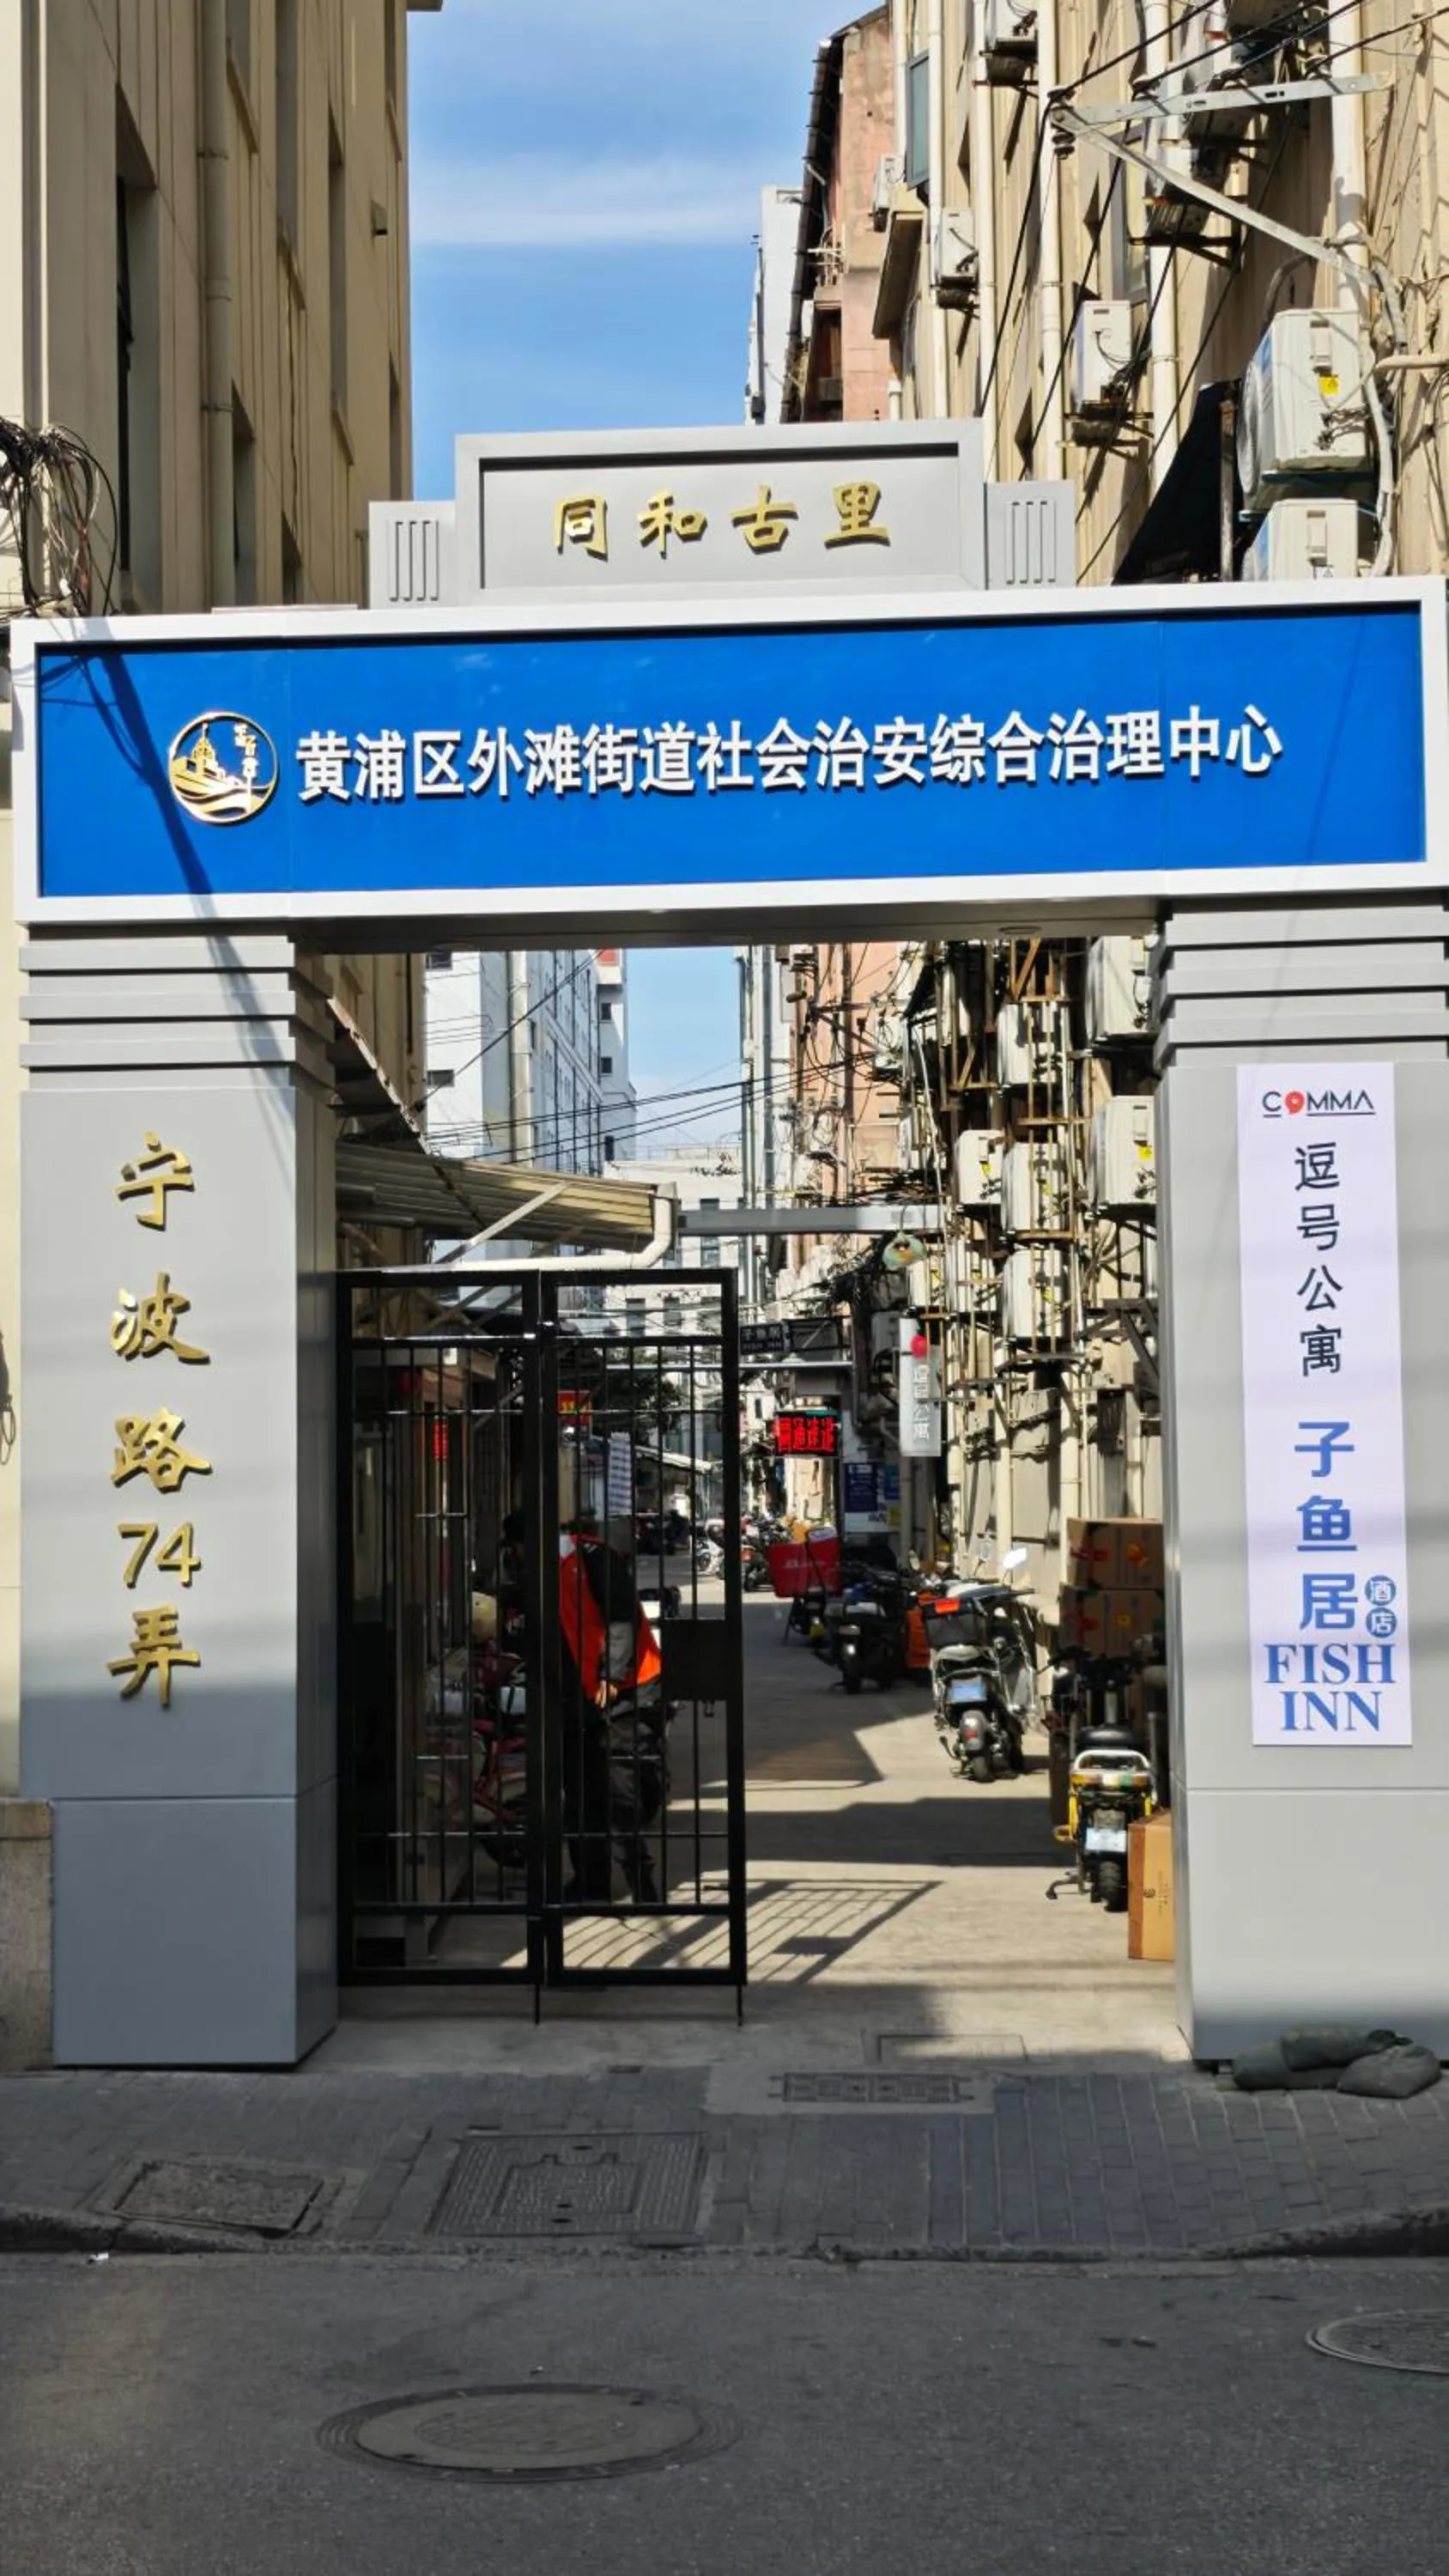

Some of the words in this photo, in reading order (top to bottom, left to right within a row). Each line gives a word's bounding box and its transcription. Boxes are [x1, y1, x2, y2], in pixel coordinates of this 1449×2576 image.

[553, 481, 890, 561] 同和古里
[295, 704, 1284, 802] 黄浦区外滩街道社会治安综合治理中心
[1294, 1142, 1343, 1376] 逗号公寓
[107, 1131, 214, 1708] 宁波路74弄
[1294, 1421, 1358, 1630] 子鱼居
[1367, 1578, 1395, 1636] 酒店
[1264, 1643, 1396, 1684] FISH
[1281, 1691, 1383, 1732] INN
